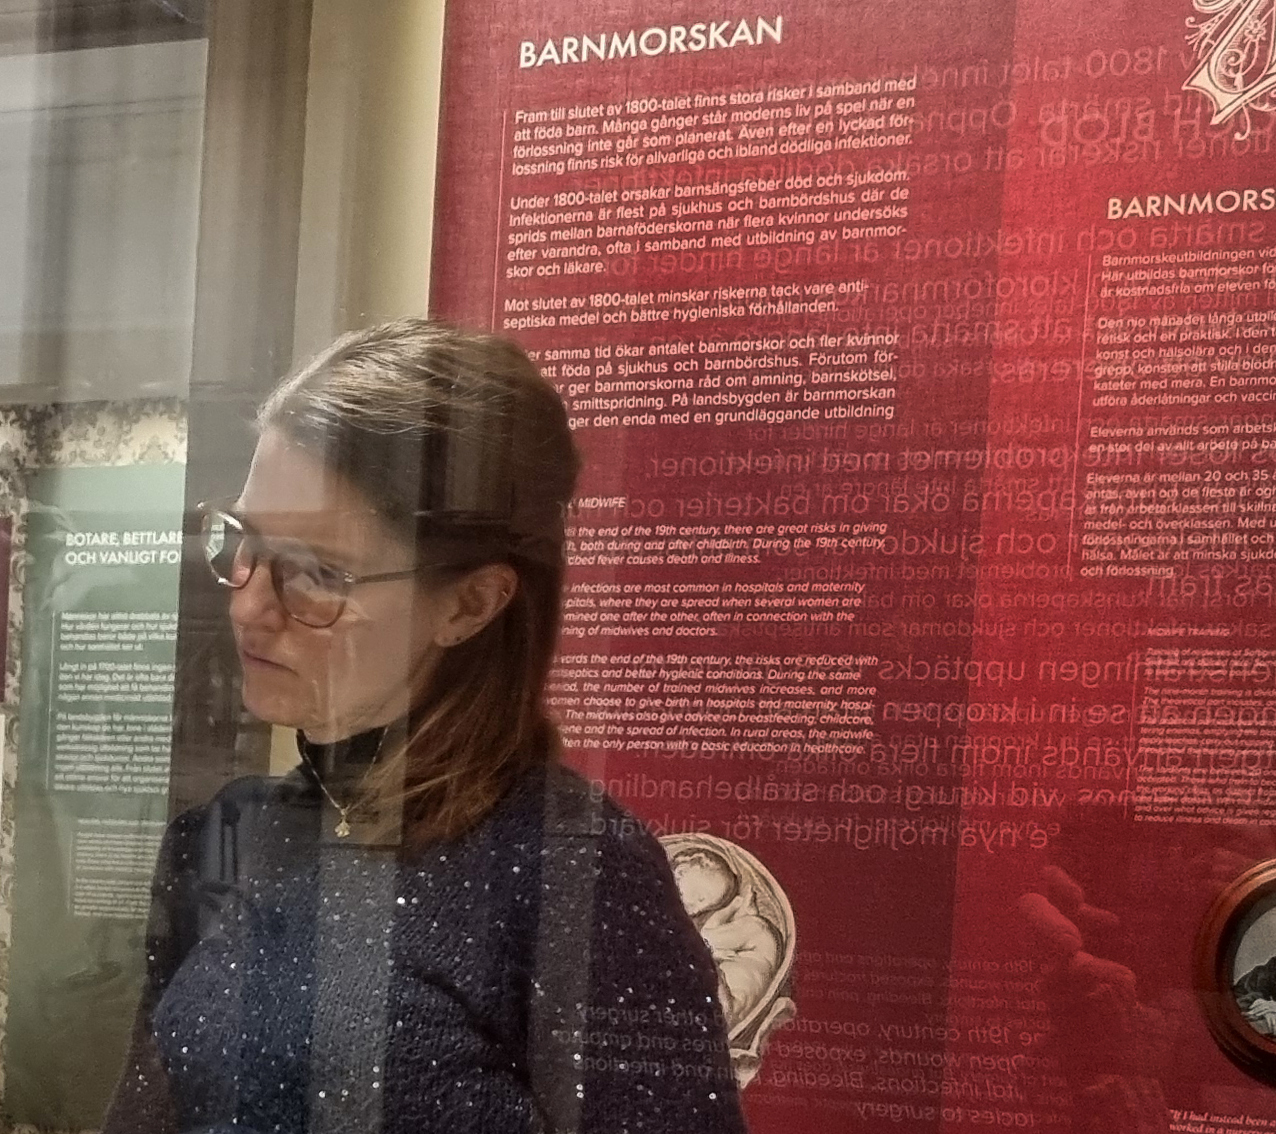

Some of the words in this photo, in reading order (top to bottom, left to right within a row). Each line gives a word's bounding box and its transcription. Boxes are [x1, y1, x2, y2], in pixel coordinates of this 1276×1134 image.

[519, 15, 783, 69] BARNMORSKAN
[515, 111, 547, 124] Fram
[550, 107, 564, 121] till
[568, 104, 603, 119] slutet
[606, 105, 622, 116] av
[626, 96, 690, 114] 1800-talet
[694, 95, 726, 108] finns
[729, 92, 763, 105] stora
[767, 87, 805, 102] risker
[816, 80, 880, 97] samband
[884, 77, 916, 91] med
[514, 128, 530, 141] att
[533, 126, 562, 140] föda
[565, 124, 598, 137] barn.
[602, 120, 647, 135] Många
[650, 117, 697, 133] gånger
[702, 112, 726, 126] står
[730, 109, 791, 123] moderns
[795, 105, 810, 118] liv
[814, 103, 832, 119] på
[836, 100, 865, 117] spel
[869, 99, 891, 112] när
[896, 99, 914, 110] en
[513, 141, 583, 158] förlossning
[587, 139, 612, 152] inte
[616, 136, 638, 152] går
[642, 136, 670, 148] som
[675, 128, 734, 148] planerat.
[738, 124, 773, 140] Även
[778, 123, 811, 136] efter
[815, 123, 833, 133] en
[838, 116, 884, 134] lyckad
[889, 114, 914, 128] för-
[512, 159, 564, 174] lossning
[567, 157, 597, 170] finns
[600, 153, 622, 167] risk
[625, 152, 643, 165] för
[646, 148, 704, 164] allvarliga
[707, 145, 732, 159] och
[735, 141, 776, 157] ibland
[779, 138, 831, 153] dödliga
[834, 133, 912, 149] infektioner.
[510, 196, 549, 210] Under
[554, 190, 617, 207] 1800-talet
[621, 187, 670, 201] orsakar
[674, 178, 780, 197] barnsängsfeber
[784, 175, 811, 189] död
[816, 172, 842, 187] och
[846, 169, 909, 186] sjukdom.
[1107, 188, 1276, 219] BARNMORS
[509, 210, 593, 225] Infektionerna
[598, 207, 611, 219] är
[616, 204, 643, 218] flest
[649, 203, 665, 219] på
[671, 200, 722, 217] sjukhus
[727, 197, 753, 211] och
[759, 191, 855, 209] barnbördshus
[861, 189, 884, 202] där
[890, 187, 908, 200] de
[508, 229, 546, 245] sprids
[550, 226, 592, 240] mellan
[596, 219, 712, 237] barnaföderskorna
[717, 216, 739, 229] när
[743, 214, 773, 227] flera
[778, 211, 828, 225] kvinnor
[834, 205, 907, 221] undersöks
[507, 247, 536, 261] efter
[541, 244, 601, 258] varandra,
[606, 241, 631, 254] ofta
[644, 236, 705, 252] samband
[711, 234, 740, 248] med
[746, 230, 814, 246] utbildning
[819, 231, 836, 241] av
[842, 226, 907, 240] barnmor-
[1102, 248, 1254, 266] Barnmorskeutbildningen
[506, 264, 533, 277] skor
[536, 261, 560, 275] och
[563, 260, 607, 273] läkare.
[1126, 267, 1175, 280] utbildas
[1179, 263, 1258, 278] barnmorskor
[504, 297, 528, 311] Mot
[531, 295, 566, 309] slutet
[570, 297, 585, 307] av
[589, 290, 653, 306] 1800-talet
[657, 288, 709, 302] minskar
[713, 286, 766, 299] riskerna
[771, 282, 799, 296] tack
[804, 283, 834, 294] vare
[838, 279, 869, 292] anti-
[1194, 283, 1213, 293] om
[1217, 279, 1259, 291] eleven
[503, 313, 555, 330] septiska
[559, 310, 599, 325] medel
[602, 309, 626, 322] och
[630, 307, 669, 321] bättre
[673, 303, 744, 321] hygieniska
[748, 299, 838, 314] förhållanden.
[1092, 394, 1127, 406] utföra
[1130, 392, 1209, 406] åderlåtningar
[1214, 391, 1237, 403] och
[1090, 425, 1143, 437] Eleverna
[1146, 423, 1198, 436] används
[1202, 425, 1228, 435] som
[65, 531, 119, 547] BOTARE,
[123, 530, 183, 545] BETTLARE
[65, 551, 96, 565] OCH
[100, 550, 157, 565] VANLIGT
[159, 550, 181, 564] FO
[1080, 564, 1102, 576] och
[571, 582, 620, 592] infections
[623, 584, 641, 592] are
[644, 582, 670, 592] most
[672, 584, 719, 592] common
[722, 582, 731, 592] in
[734, 582, 783, 594] hospitals
[786, 582, 808, 592] and
[811, 582, 863, 594] maternity
